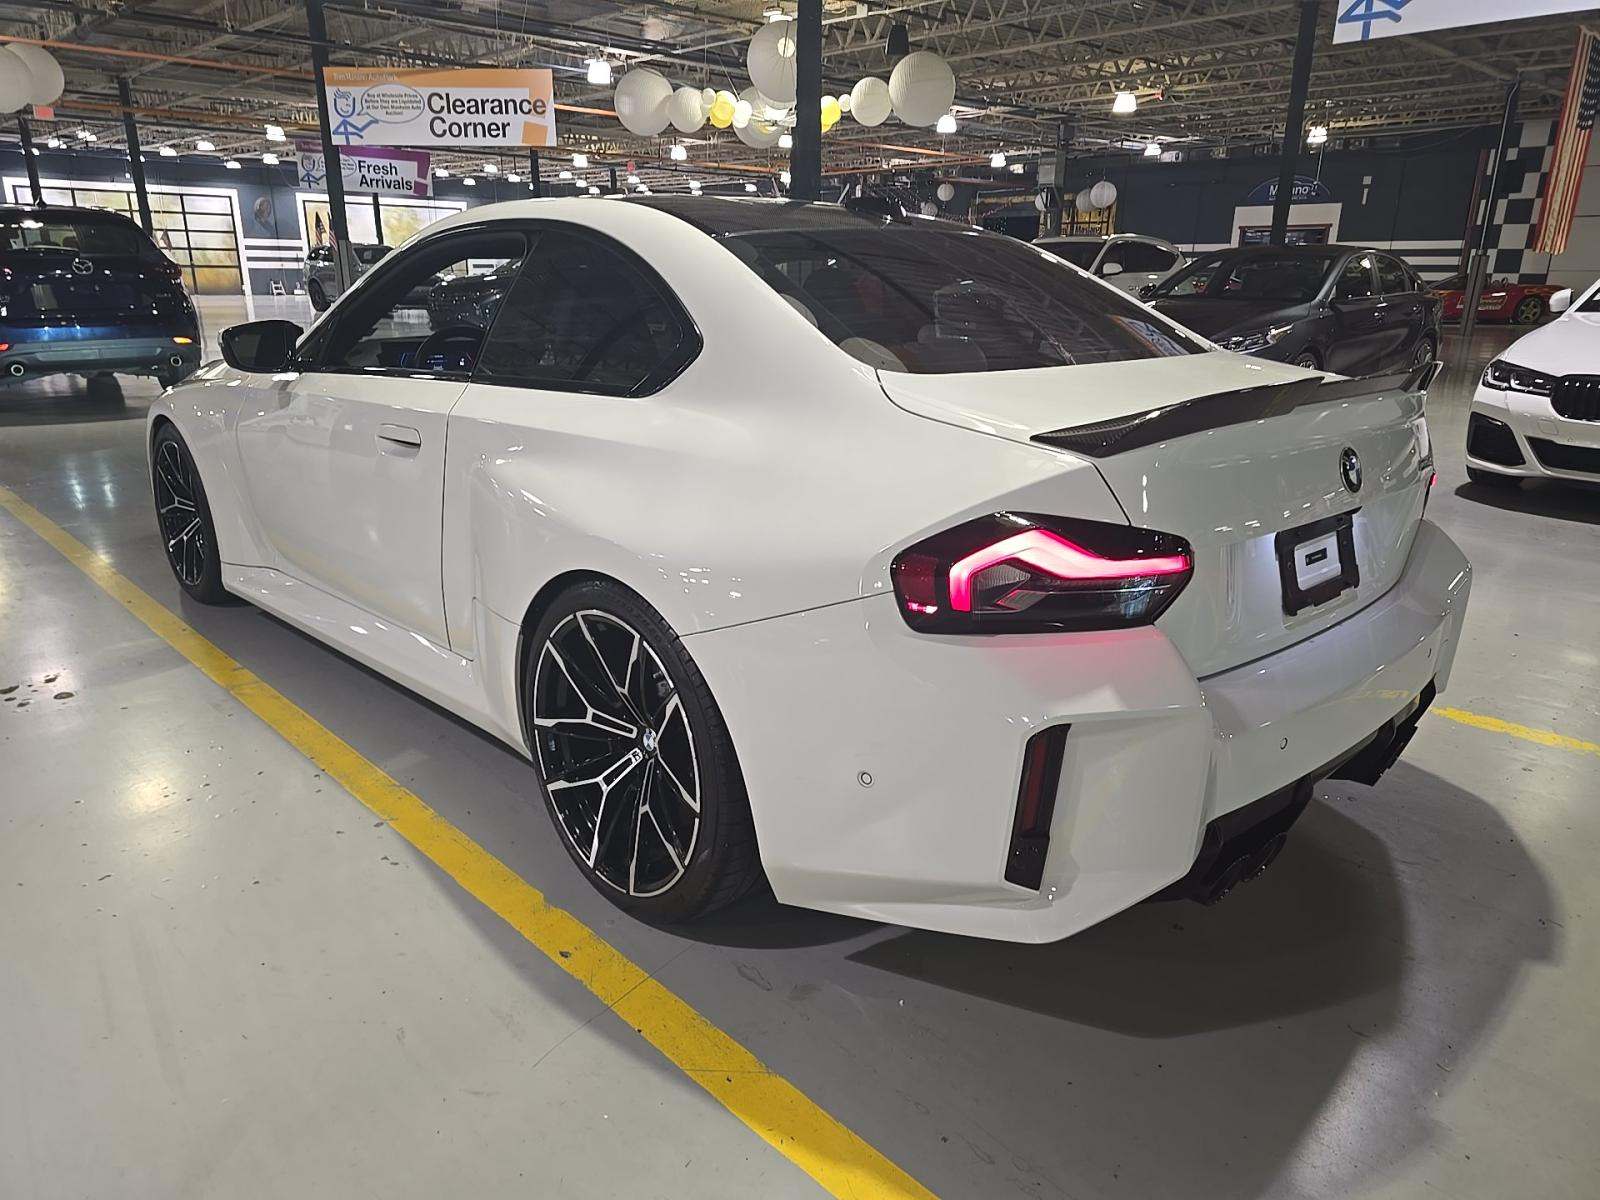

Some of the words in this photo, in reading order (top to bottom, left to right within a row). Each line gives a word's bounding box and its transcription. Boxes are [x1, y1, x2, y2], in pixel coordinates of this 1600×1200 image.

[427, 92, 546, 115] Clearance
[429, 116, 511, 138] Corner
[358, 160, 398, 176] Fresh
[360, 174, 413, 190] Arrivals
